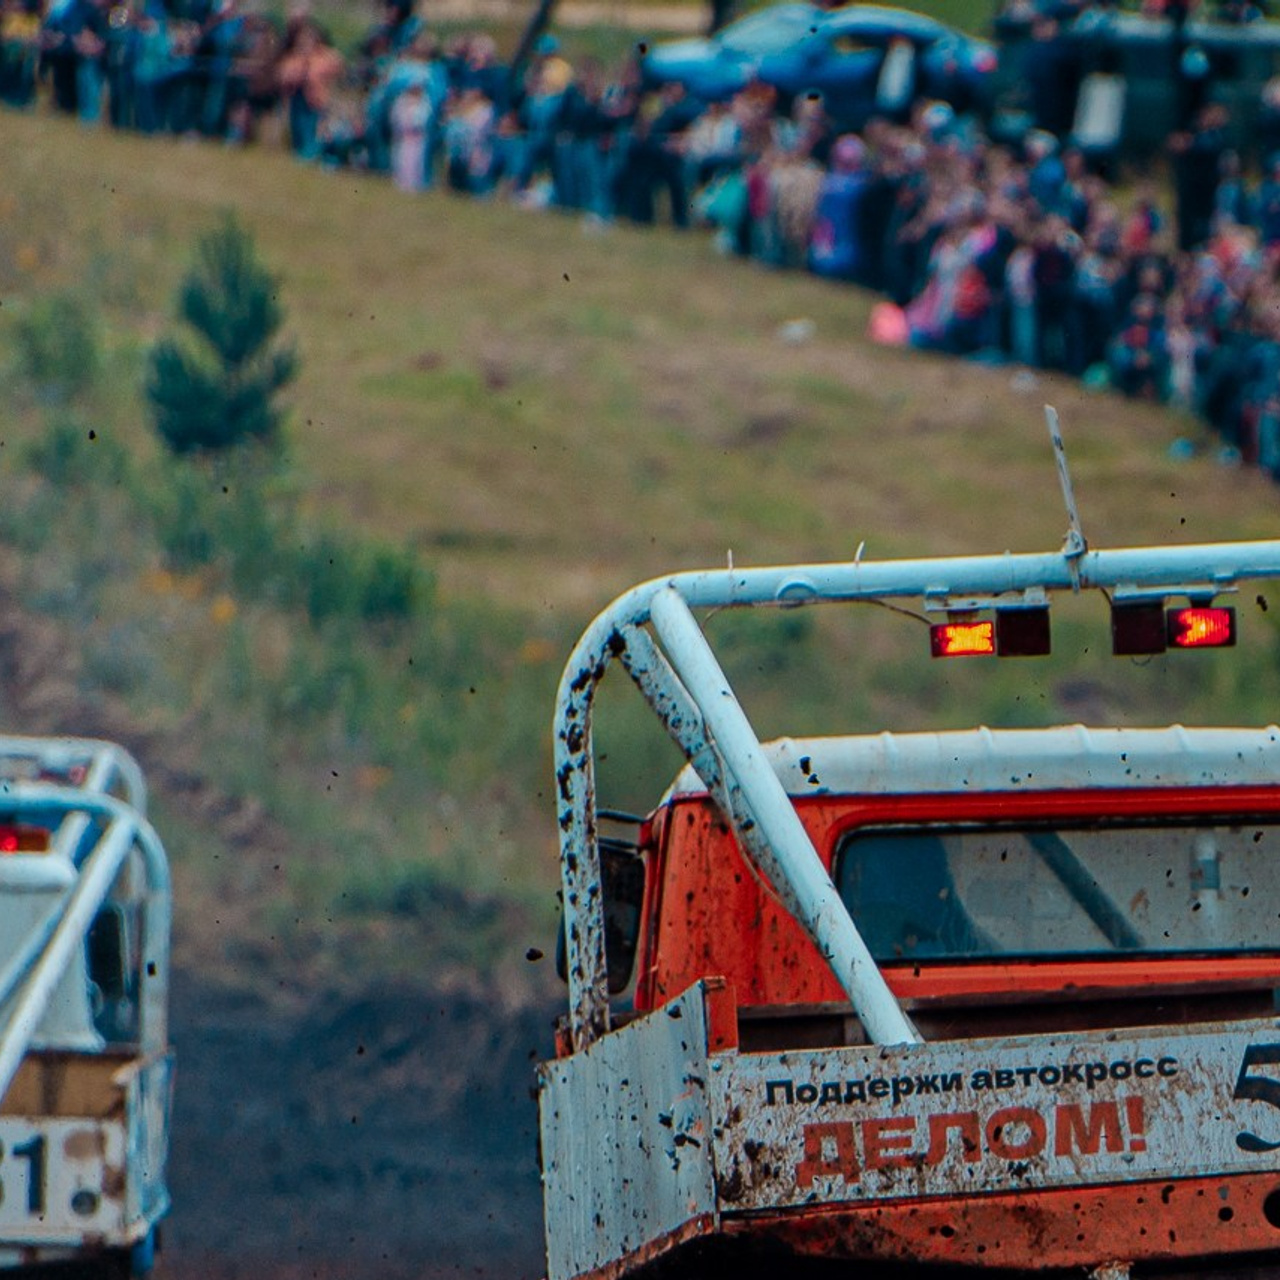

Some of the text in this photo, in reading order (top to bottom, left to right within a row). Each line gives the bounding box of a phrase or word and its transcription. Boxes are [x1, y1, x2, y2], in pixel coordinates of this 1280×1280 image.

[766, 1055, 1179, 1107] Поддержи автокросс
[0, 1132, 46, 1216] 1
[795, 1095, 1148, 1188] ДЕЛОМ!
